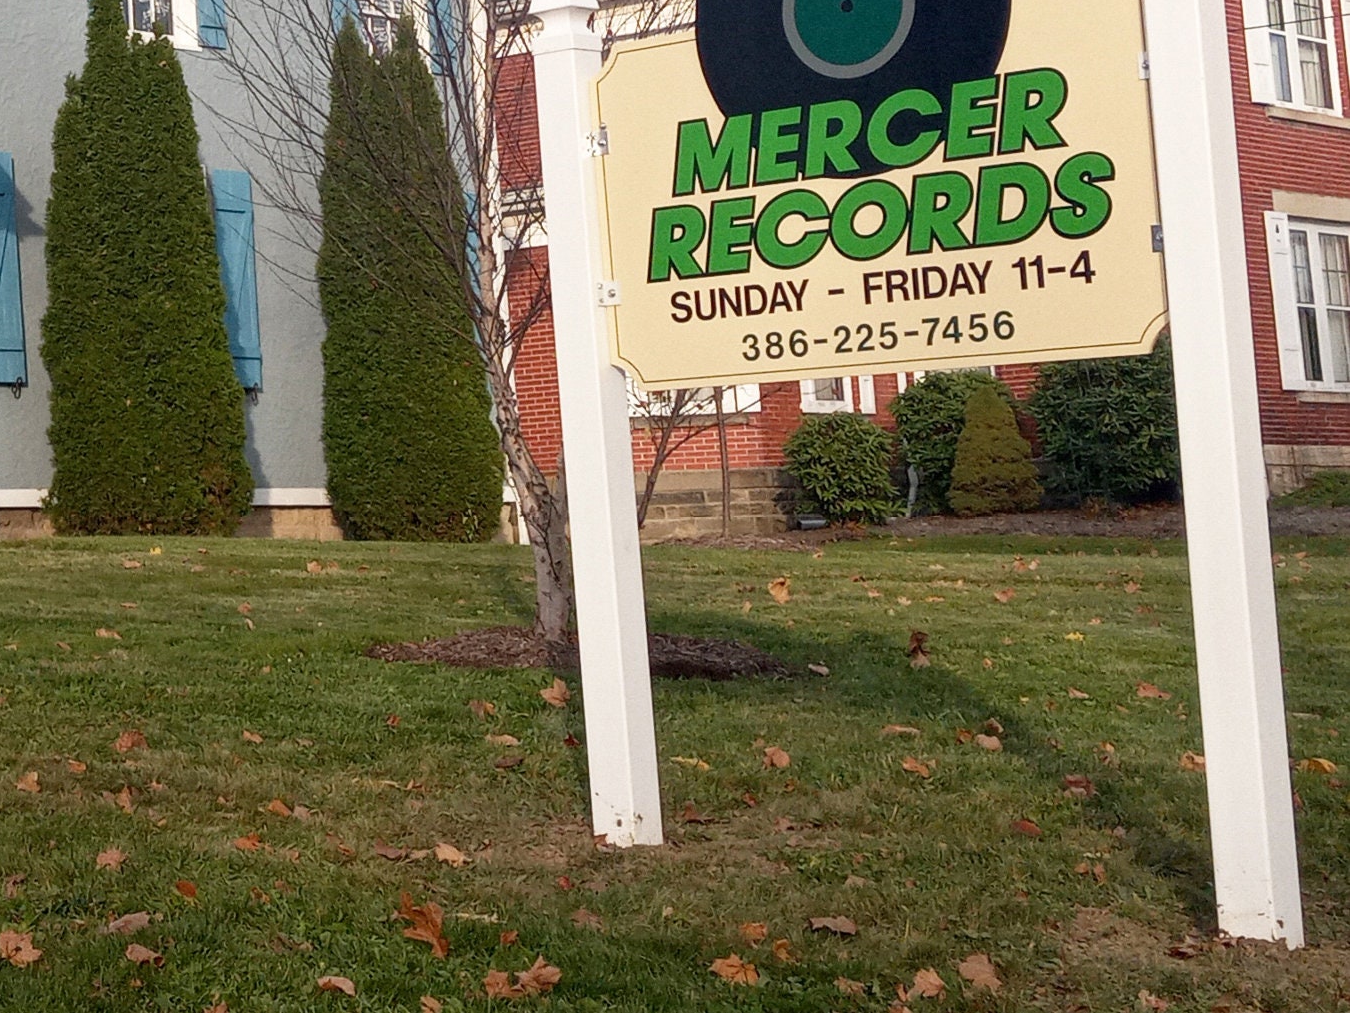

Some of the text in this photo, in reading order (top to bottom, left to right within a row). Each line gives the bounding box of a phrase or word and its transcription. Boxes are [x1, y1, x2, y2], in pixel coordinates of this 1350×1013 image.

[672, 67, 1069, 197] MERCER
[647, 151, 1116, 283] RECORDS
[670, 250, 1096, 323] SUNDAY - FRIDAY 11-4
[741, 310, 1017, 362] 386-225-7456
